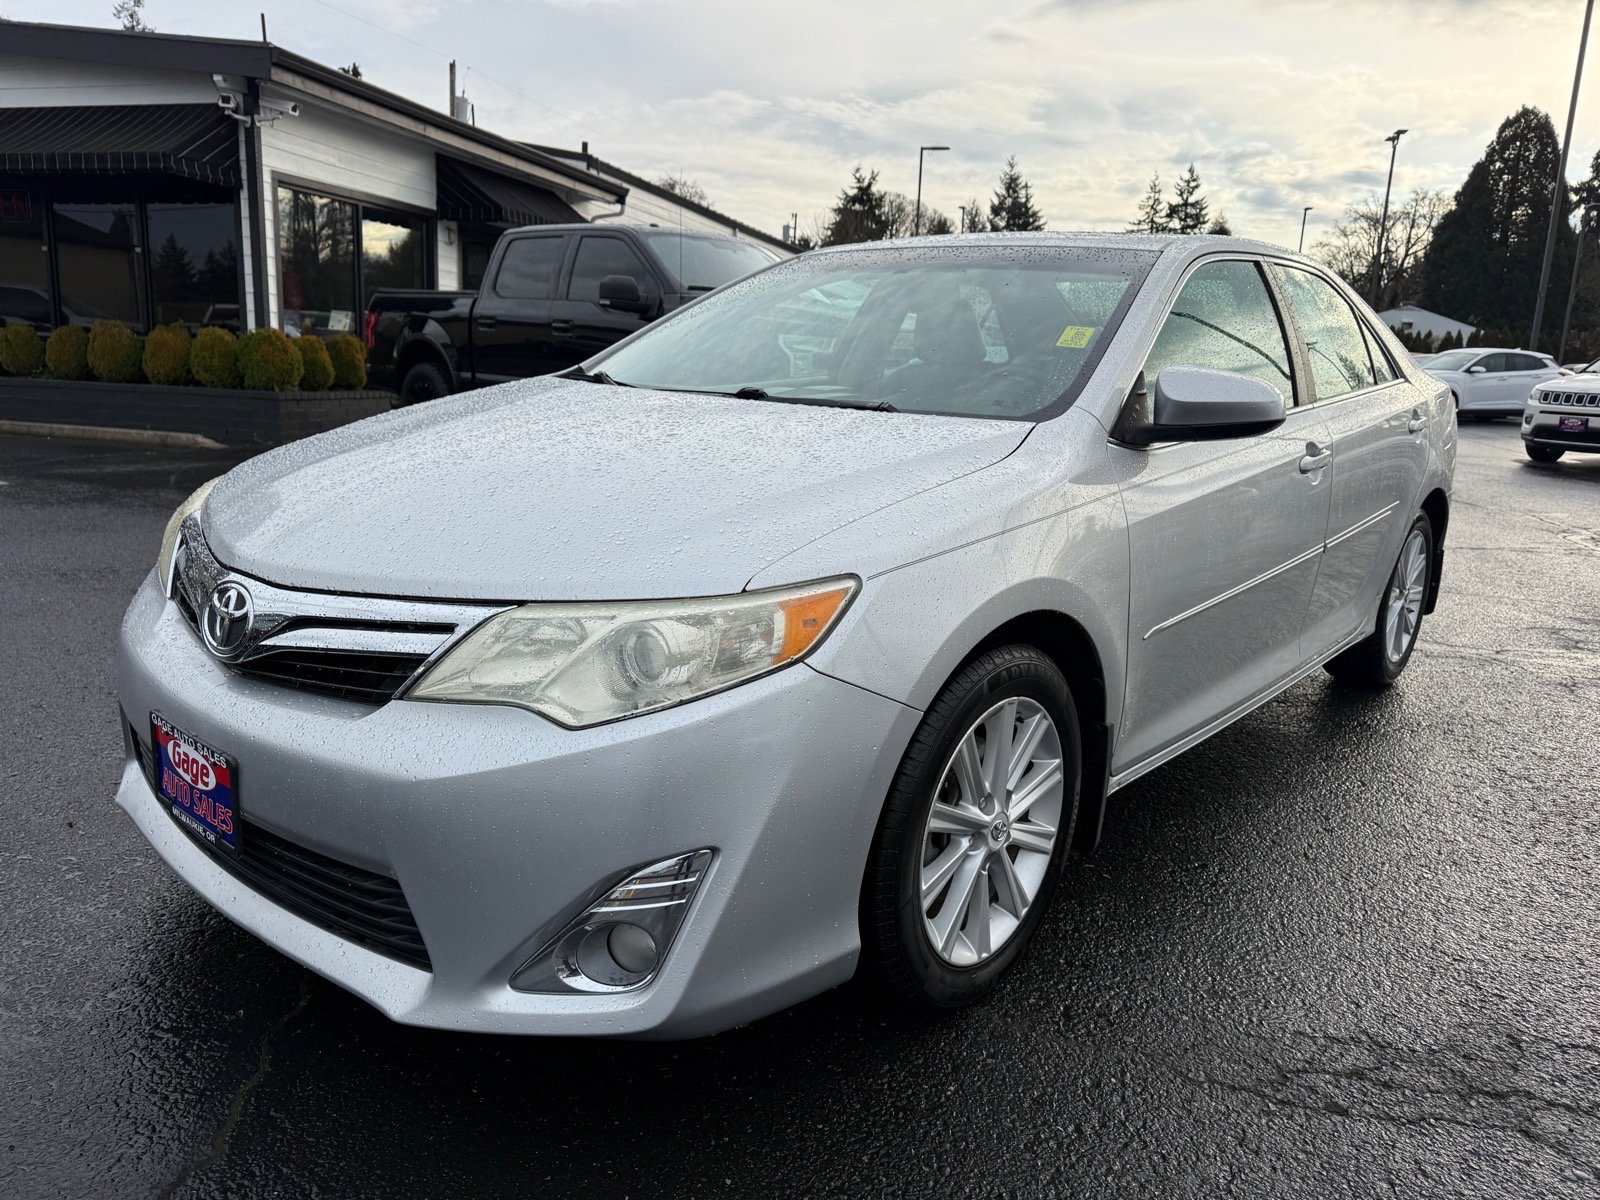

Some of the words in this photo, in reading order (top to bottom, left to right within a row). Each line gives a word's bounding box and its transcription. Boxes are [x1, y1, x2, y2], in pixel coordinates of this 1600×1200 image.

[151, 713, 173, 735] GAGE
[174, 728, 196, 749] AUTO
[197, 743, 227, 769] SALES
[172, 740, 210, 787] Gage
[162, 766, 190, 808] AUTO
[193, 789, 233, 835] SALES
